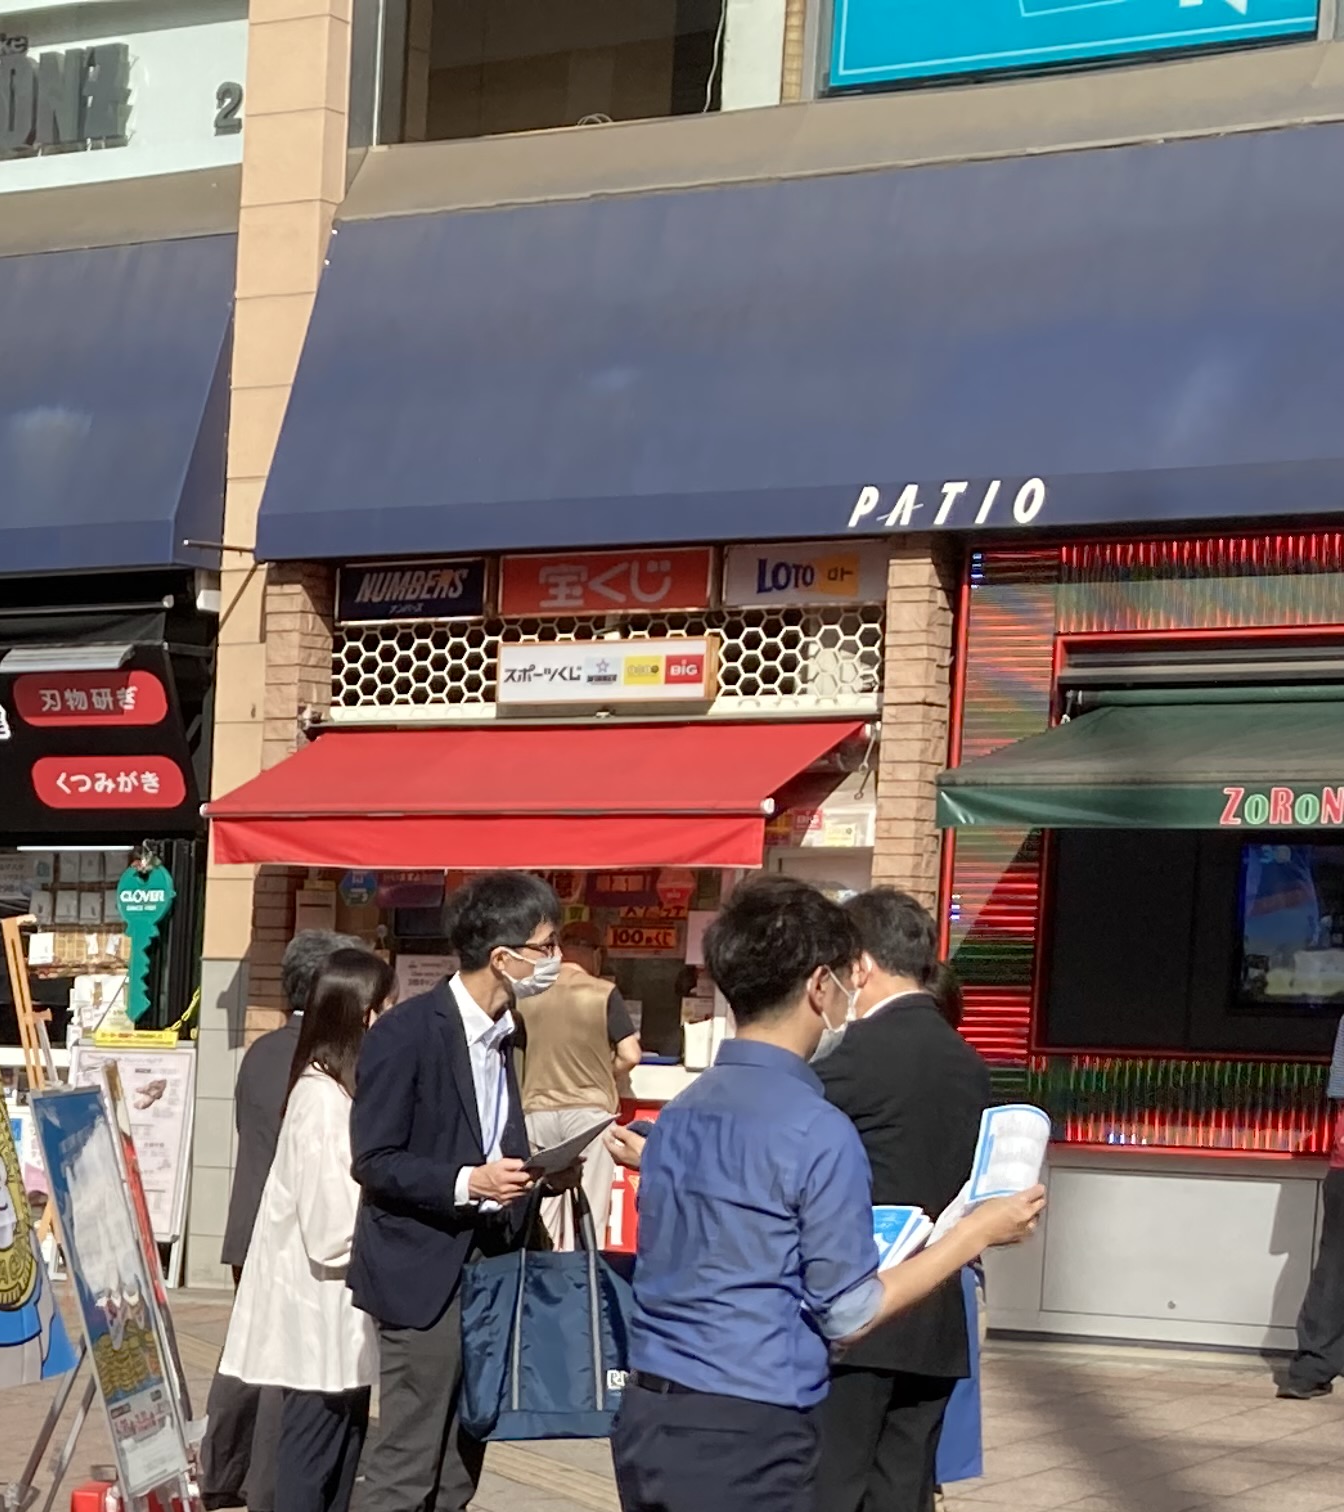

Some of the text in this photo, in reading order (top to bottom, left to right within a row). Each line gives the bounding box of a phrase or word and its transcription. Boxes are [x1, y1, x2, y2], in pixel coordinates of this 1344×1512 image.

[847, 477, 1046, 528] PATIO
[355, 568, 470, 603] NUMBERS
[539, 559, 671, 609] 宝くじ
[756, 557, 815, 594] LOTO
[503, 664, 582, 684] スポーツくじ
[38, 685, 139, 712] 刃物研ぎ
[56, 770, 161, 794] くつみがき
[119, 889, 165, 903] CLOVER
